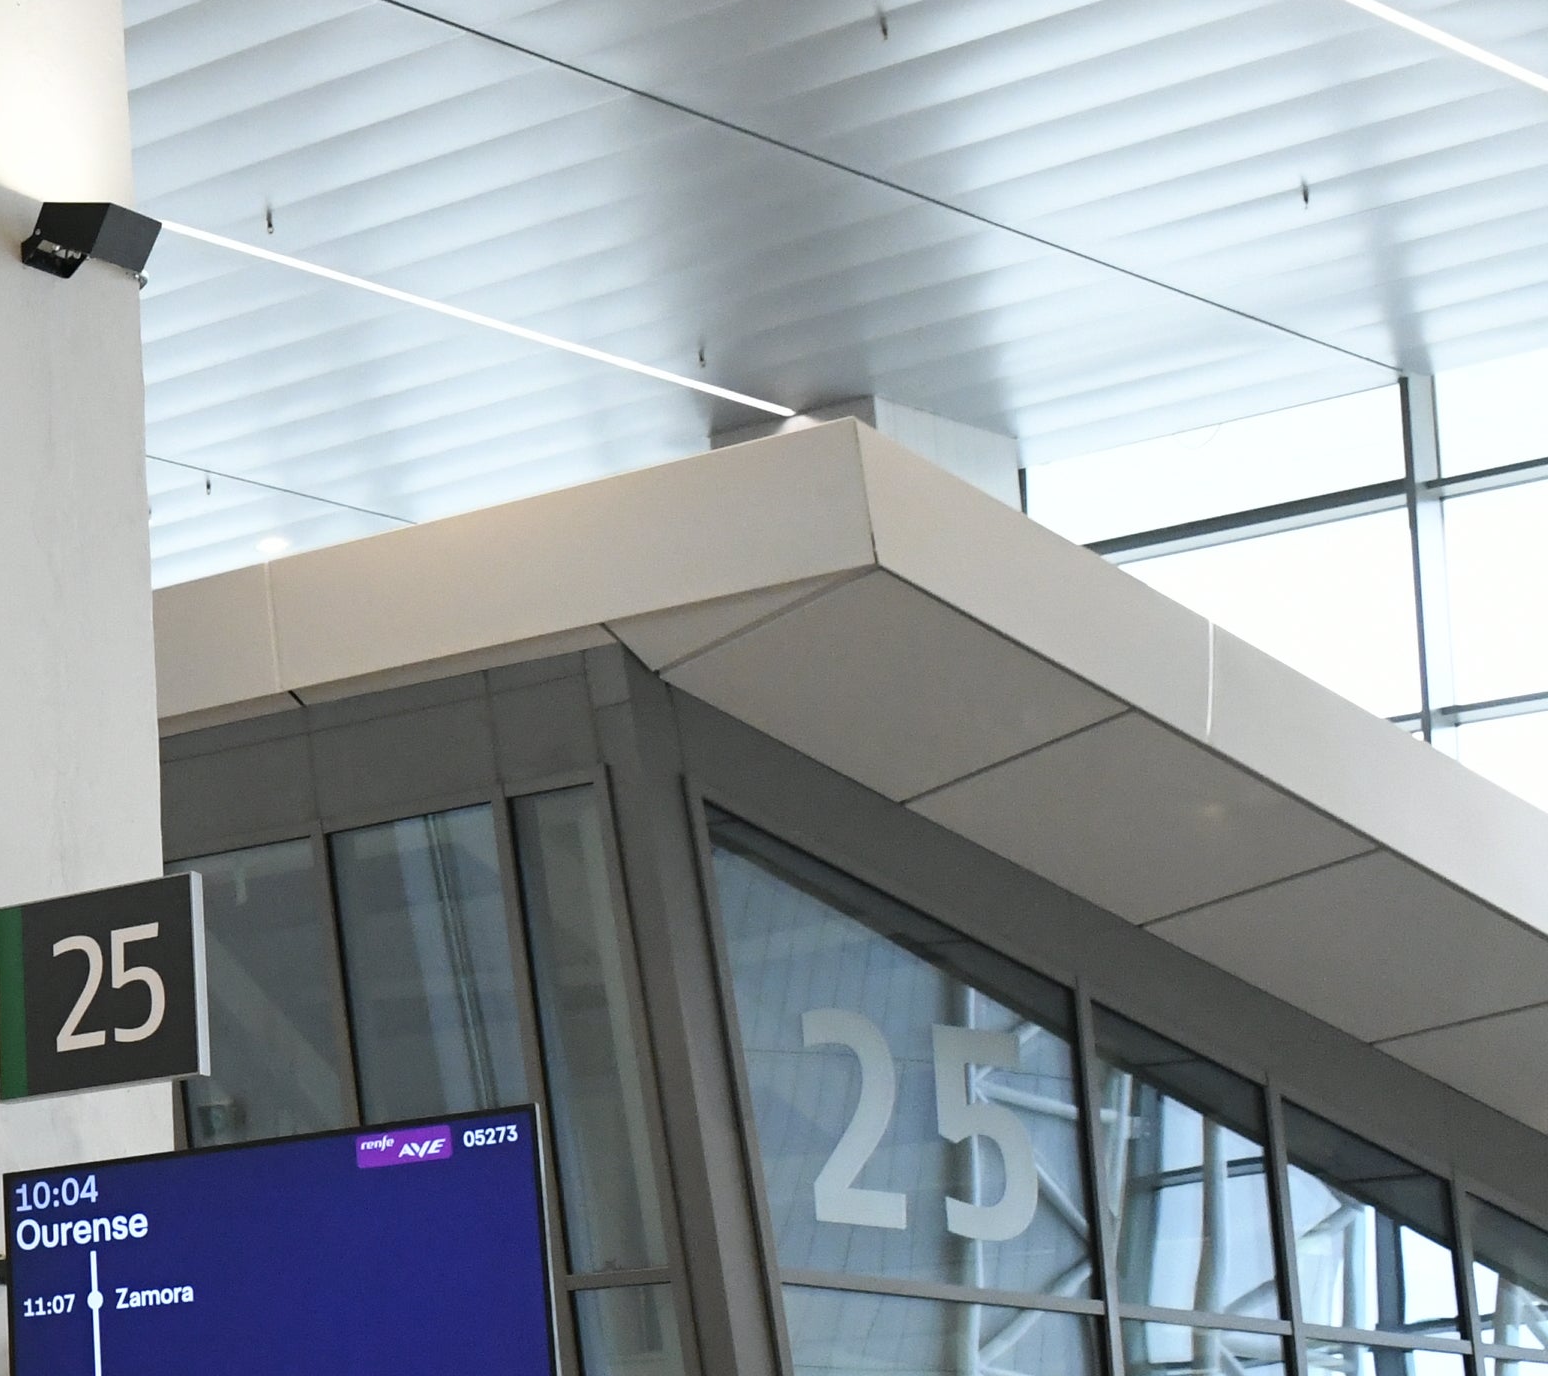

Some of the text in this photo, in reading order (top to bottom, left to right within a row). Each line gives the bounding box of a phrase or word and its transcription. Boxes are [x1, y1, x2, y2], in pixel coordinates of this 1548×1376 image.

[53, 922, 165, 1052] 25
[360, 1125, 518, 1158] renfe AVE 05273
[801, 1007, 1038, 1241] 25
[15, 1174, 98, 1212] 10:04
[16, 1213, 149, 1250] Ourense
[23, 1285, 194, 1316] 11:07 Zamora
